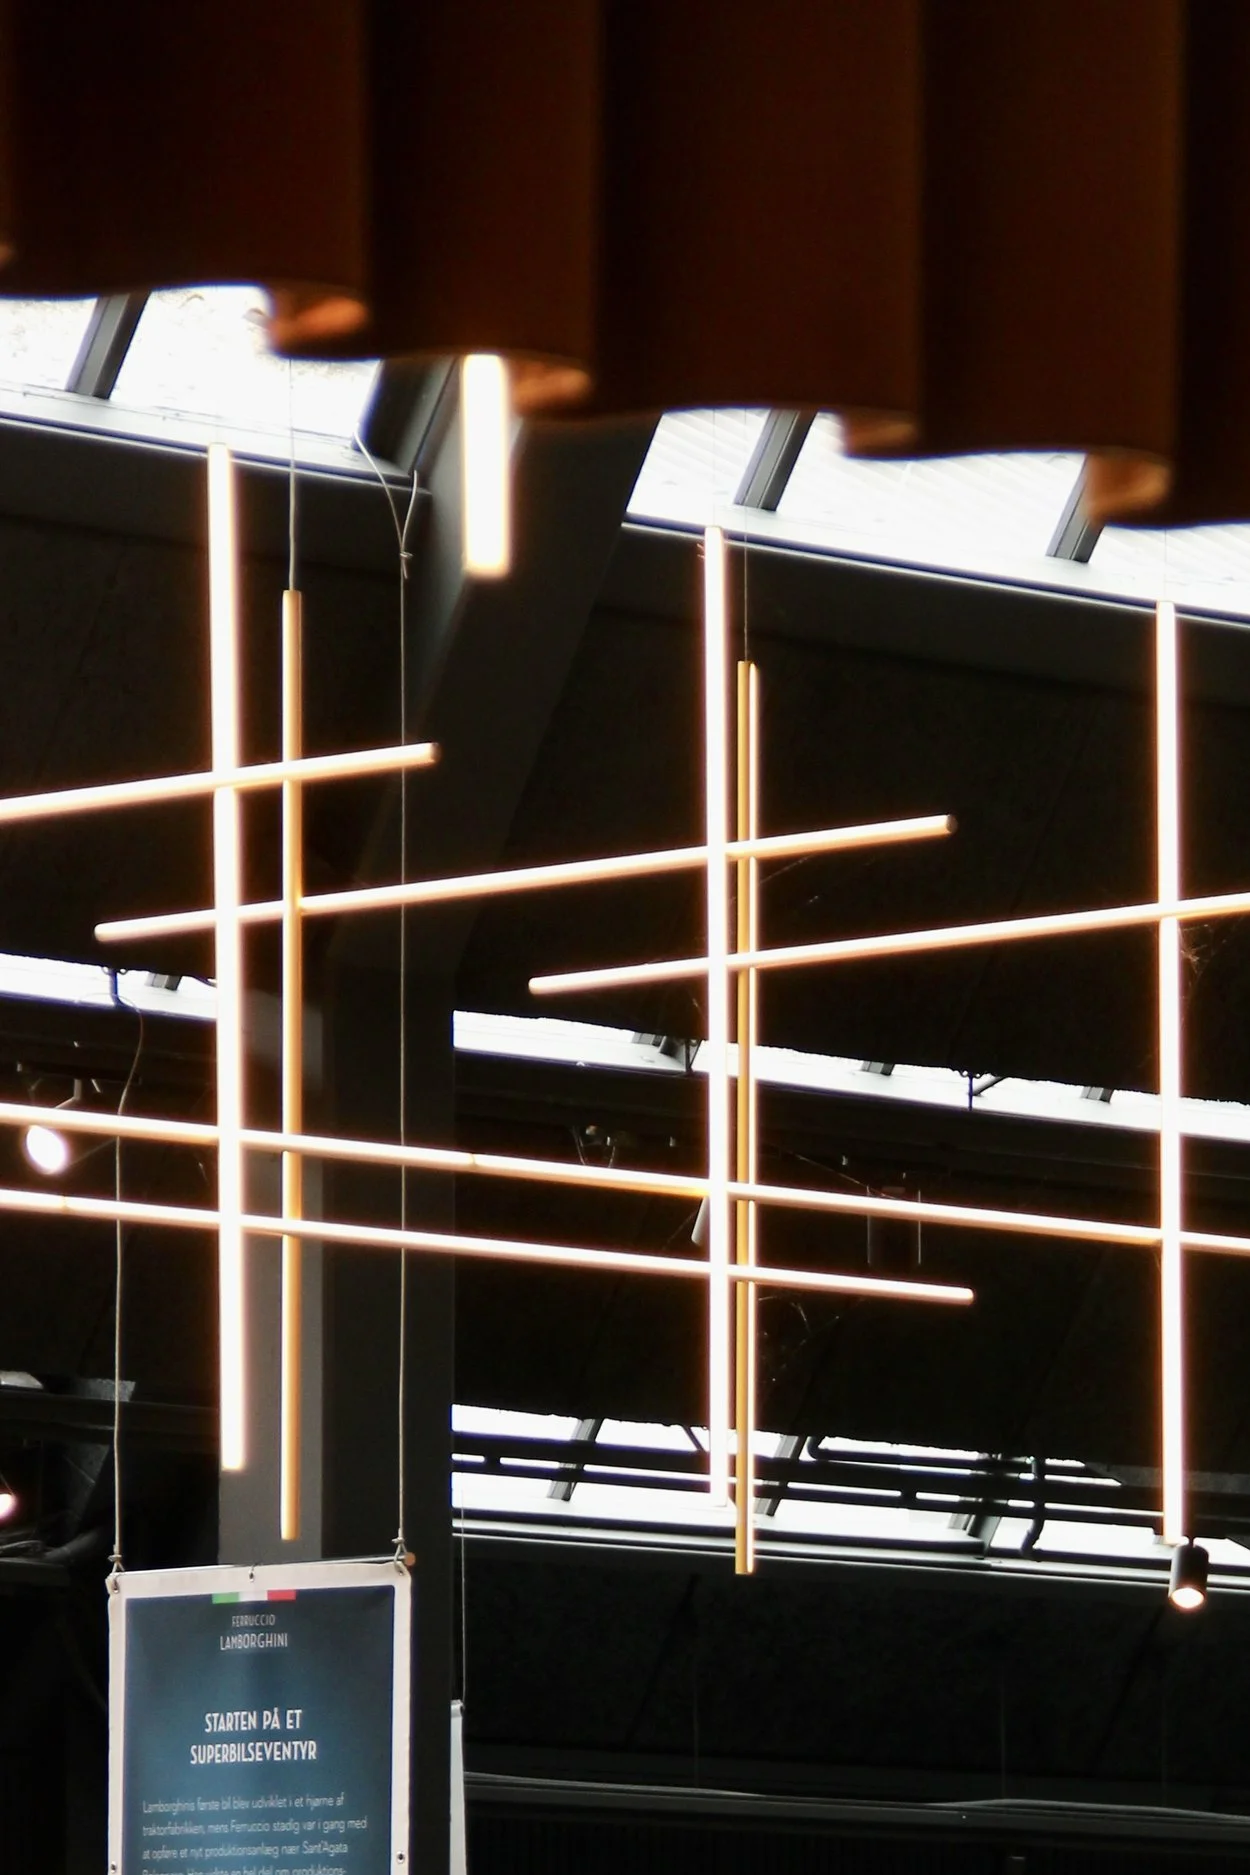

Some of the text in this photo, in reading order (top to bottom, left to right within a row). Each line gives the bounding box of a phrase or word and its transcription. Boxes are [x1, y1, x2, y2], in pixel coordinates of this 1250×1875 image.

[231, 1614, 276, 1627] FERRUCCIO
[219, 1632, 288, 1650] LAMBORGHINI
[204, 1706, 303, 1733] STARTEN PÅ ET
[189, 1740, 317, 1765] SUPERBILSEVENTYR
[208, 1824, 229, 1833] mens
[230, 1818, 270, 1833] Ferruccio
[273, 1818, 300, 1835] stadig
[302, 1821, 316, 1831] var
[323, 1821, 346, 1834] gang
[347, 1816, 368, 1829] med
[142, 1848, 151, 1860] at
[152, 1845, 178, 1861] opføre
[180, 1848, 188, 1858] et
[190, 1847, 203, 1859] nyt
[205, 1843, 279, 1860] produktionsanlæg
[281, 1846, 300, 1855] nær
